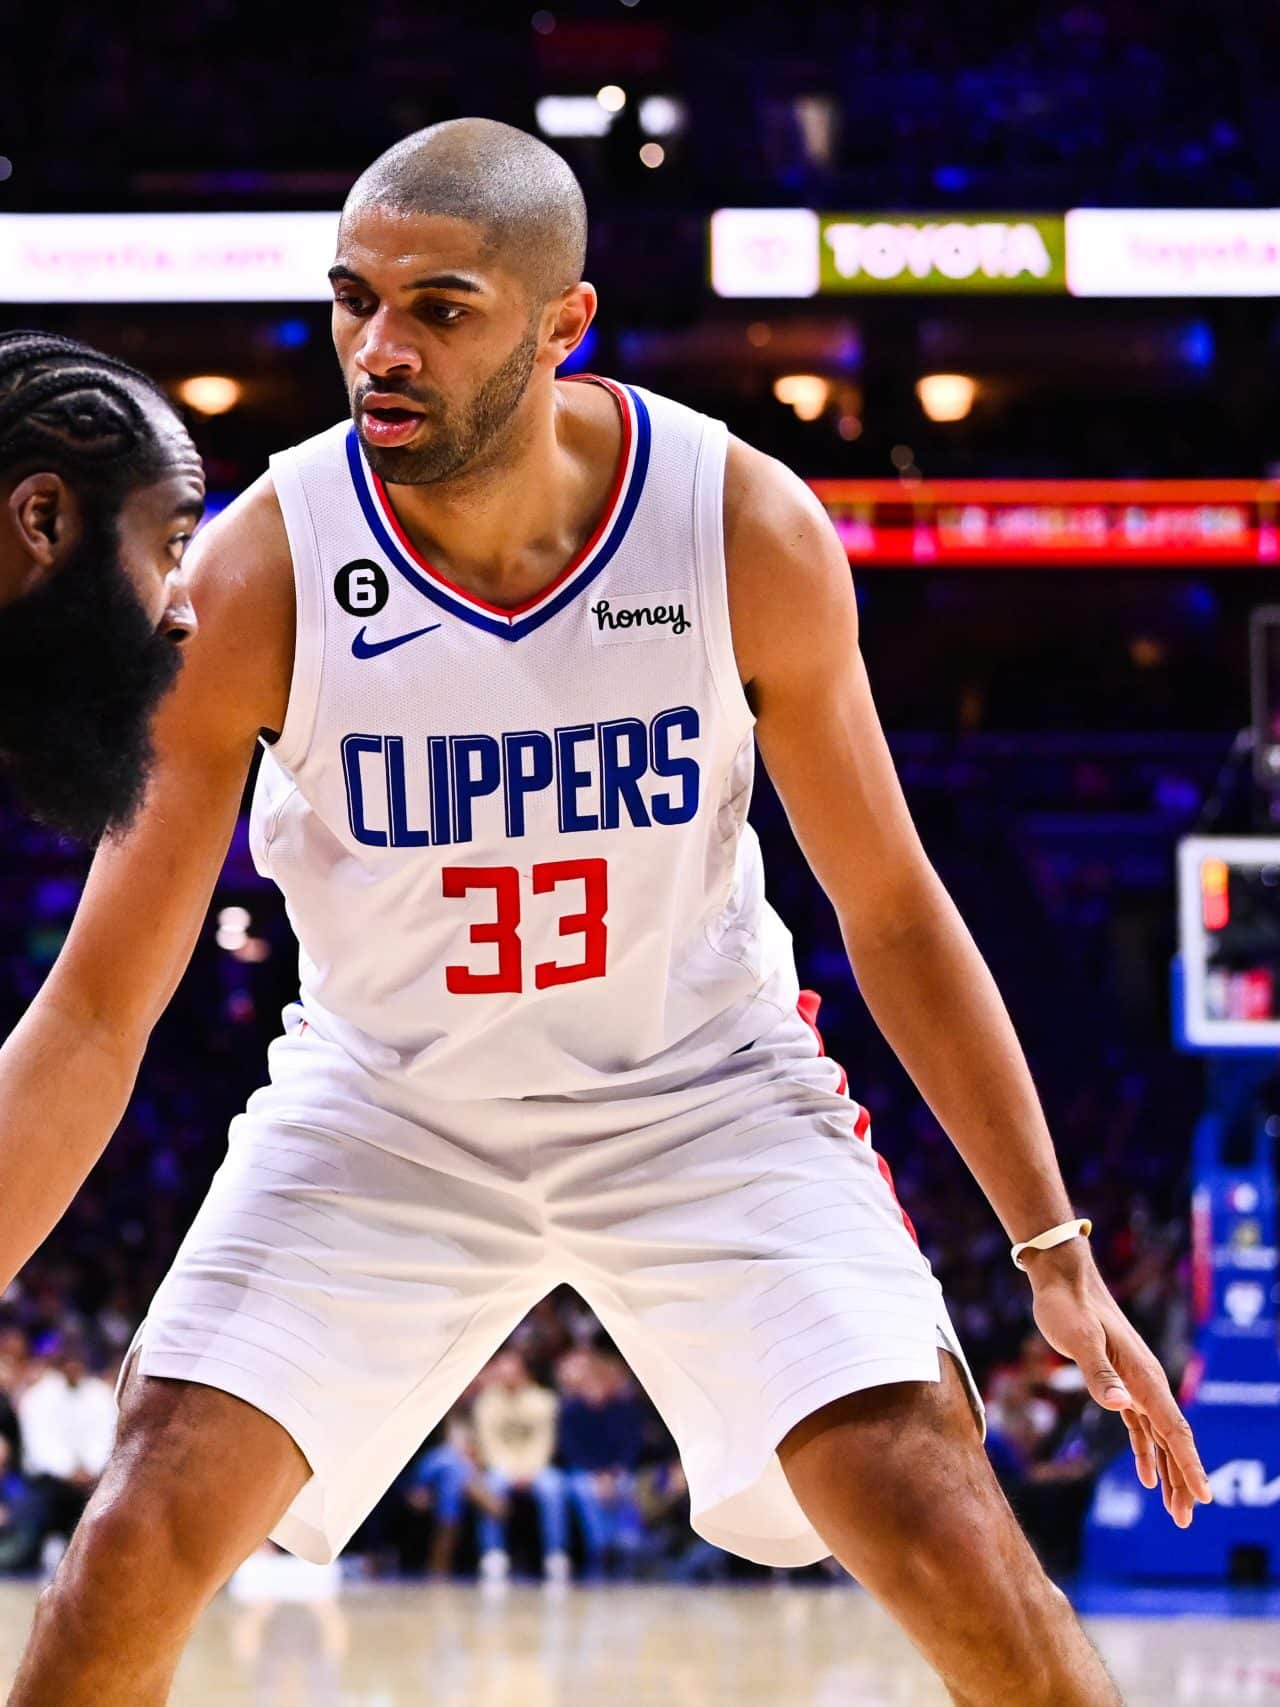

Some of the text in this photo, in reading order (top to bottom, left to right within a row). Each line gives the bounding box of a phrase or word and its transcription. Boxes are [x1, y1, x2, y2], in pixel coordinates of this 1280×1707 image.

[823, 222, 1052, 281] TOYOTA
[348, 568, 377, 609] 6
[591, 600, 691, 635] honey
[340, 705, 701, 848] CLIPPERS
[442, 857, 608, 995] 33
